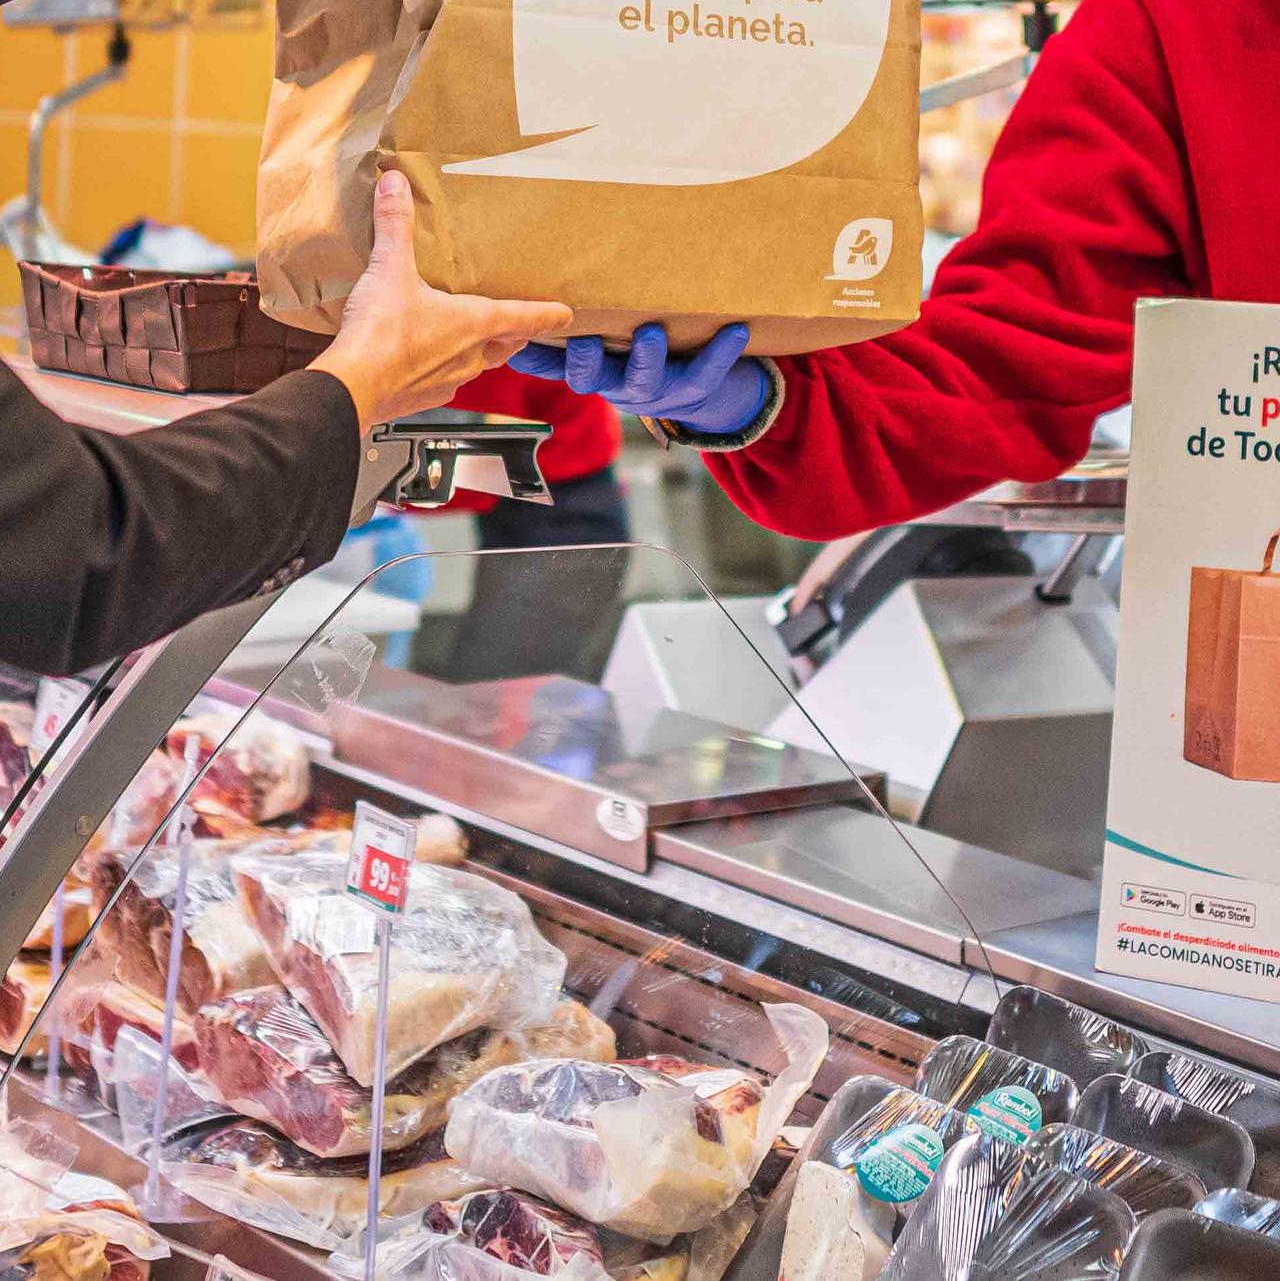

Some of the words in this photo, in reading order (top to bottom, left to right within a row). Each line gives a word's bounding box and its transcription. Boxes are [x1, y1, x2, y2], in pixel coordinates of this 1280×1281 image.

[619, 0, 655, 32] el
[668, 3, 814, 47] planeta.
[842, 287, 875, 296] Acciones
[832, 299, 880, 308] responsables
[1218, 388, 1252, 417] tu
[1187, 426, 1225, 458] de
[369, 858, 389, 891] 99
[1140, 895, 1164, 907] Google
[1166, 900, 1180, 910] Play
[1209, 908, 1226, 918] App
[1228, 911, 1250, 922] Store
[1117, 923, 1161, 938] ¡Combate
[1163, 927, 1171, 939] el
[996, 1092, 1036, 1118] Rambol
